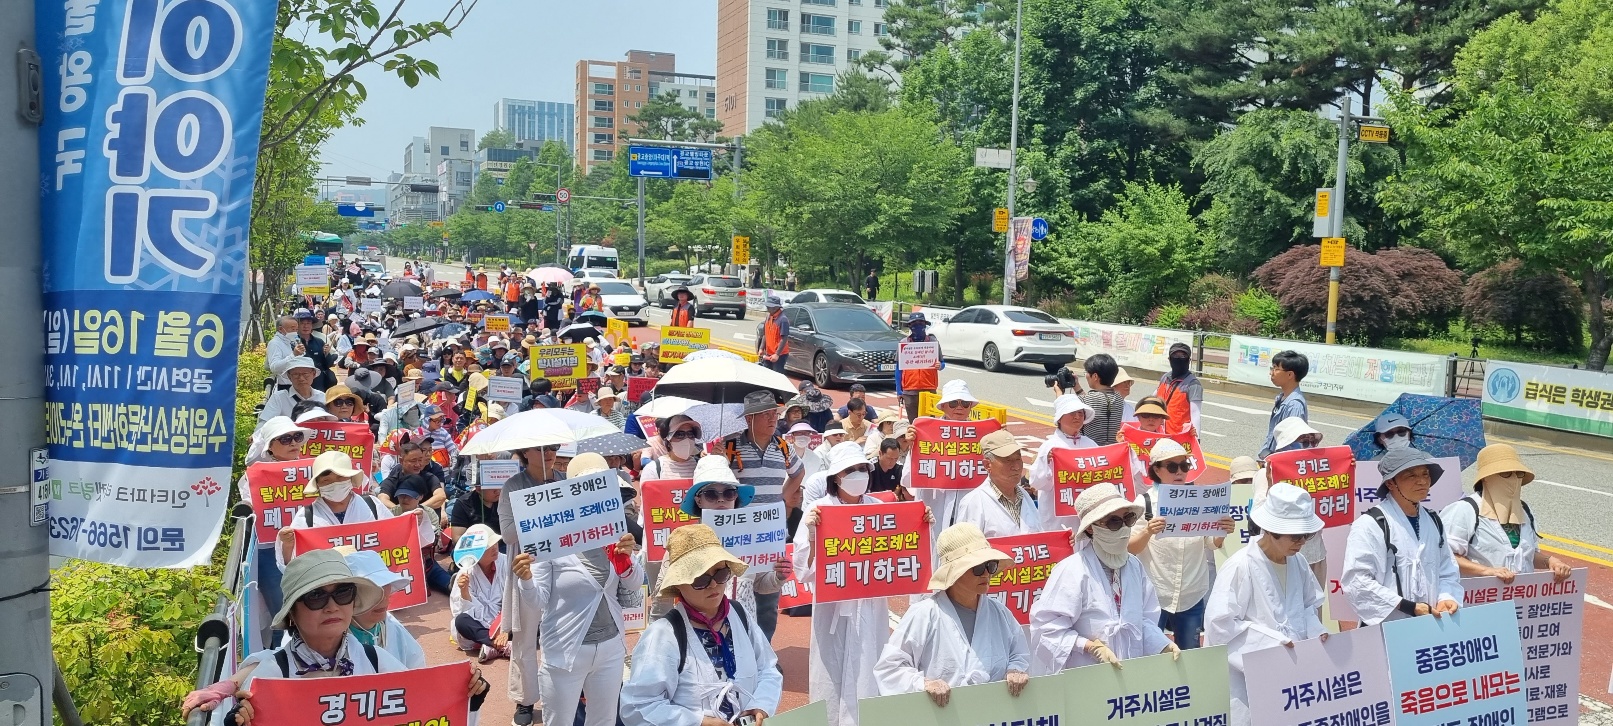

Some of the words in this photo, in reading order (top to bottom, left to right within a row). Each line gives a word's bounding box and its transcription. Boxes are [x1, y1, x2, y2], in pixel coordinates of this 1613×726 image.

[1360, 129, 1375, 138] CCTV
[539, 346, 575, 357] 우리모두는
[1524, 380, 1567, 405] 급식은
[308, 428, 346, 442] 경기도
[939, 425, 977, 440] 경기도
[918, 440, 983, 456] 탈시설조례
[1074, 454, 1109, 469] 경기도
[1295, 457, 1331, 476] 경기도
[282, 466, 313, 483] 경기
[1057, 466, 1124, 485] 탈시설조례안
[523, 486, 564, 507] 경기도
[569, 475, 608, 497] 장애인
[1168, 487, 1198, 499] 경기도
[1202, 486, 1228, 499] 장애인
[519, 508, 575, 534] 탈시설지원
[579, 497, 620, 518] 조례(안)
[1159, 506, 1200, 517] 탈시설지원
[1312, 493, 1351, 518] 하라
[713, 513, 748, 527] 경기도
[752, 507, 780, 524] 장애인
[851, 513, 898, 534] 경기도
[523, 539, 552, 558] 즉각
[558, 520, 626, 549] 폐기하라!!
[755, 527, 786, 544] 조례(안)
[824, 530, 920, 557] 탈시설조례안
[1011, 544, 1051, 562] 경기도
[824, 555, 922, 588] 폐기하라
[988, 562, 1058, 587] 탈시설조
[1501, 583, 1538, 601] 감옥이
[1541, 579, 1579, 597] 아니다.
[1527, 600, 1573, 619] 잘안되는
[1537, 621, 1561, 639] 모여
[1415, 634, 1500, 675] 중증장애인
[1526, 640, 1573, 661] 전문가와
[1282, 670, 1363, 712] 거주시설은
[1400, 679, 1469, 716] 죽음으로
[1472, 670, 1521, 701] 내모는
[318, 688, 408, 724] 경기도
[1106, 684, 1191, 721] 거주시설은
